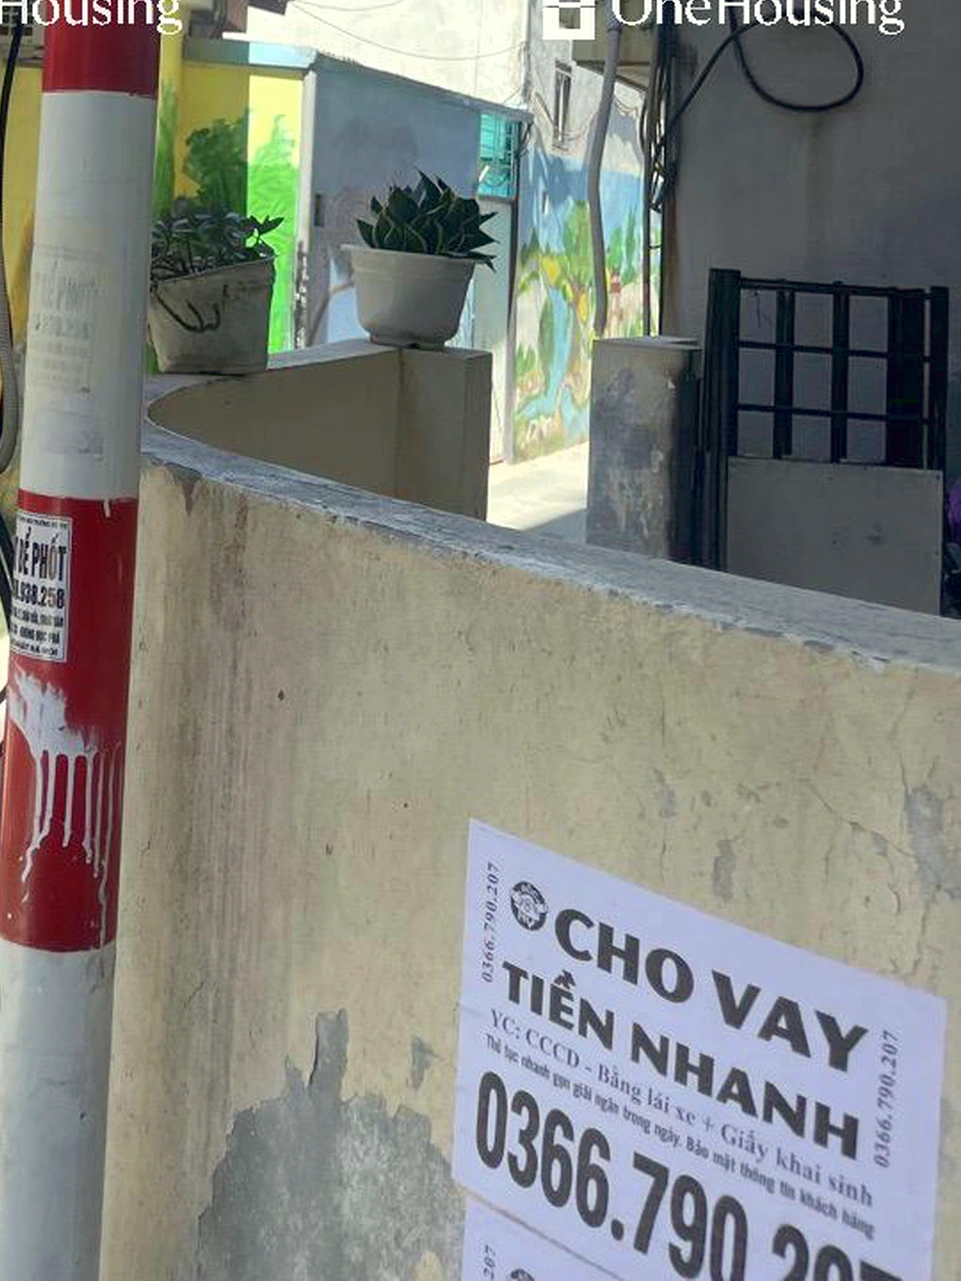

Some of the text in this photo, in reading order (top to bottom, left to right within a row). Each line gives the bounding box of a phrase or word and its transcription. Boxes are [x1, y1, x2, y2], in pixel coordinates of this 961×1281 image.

[31, 533, 67, 582] PHỐT
[501, 960, 860, 1160] TIỀN NHANH
[553, 908, 868, 1072] CHO VAY
[526, 1028, 580, 1068] CCCD
[598, 1063, 642, 1105] Bằng
[647, 1088, 670, 1114] lái
[674, 1106, 696, 1127] xe
[776, 1147, 821, 1185] khai
[828, 1174, 874, 1207] sinh
[872, 1029, 900, 1169] 0366.790.207
